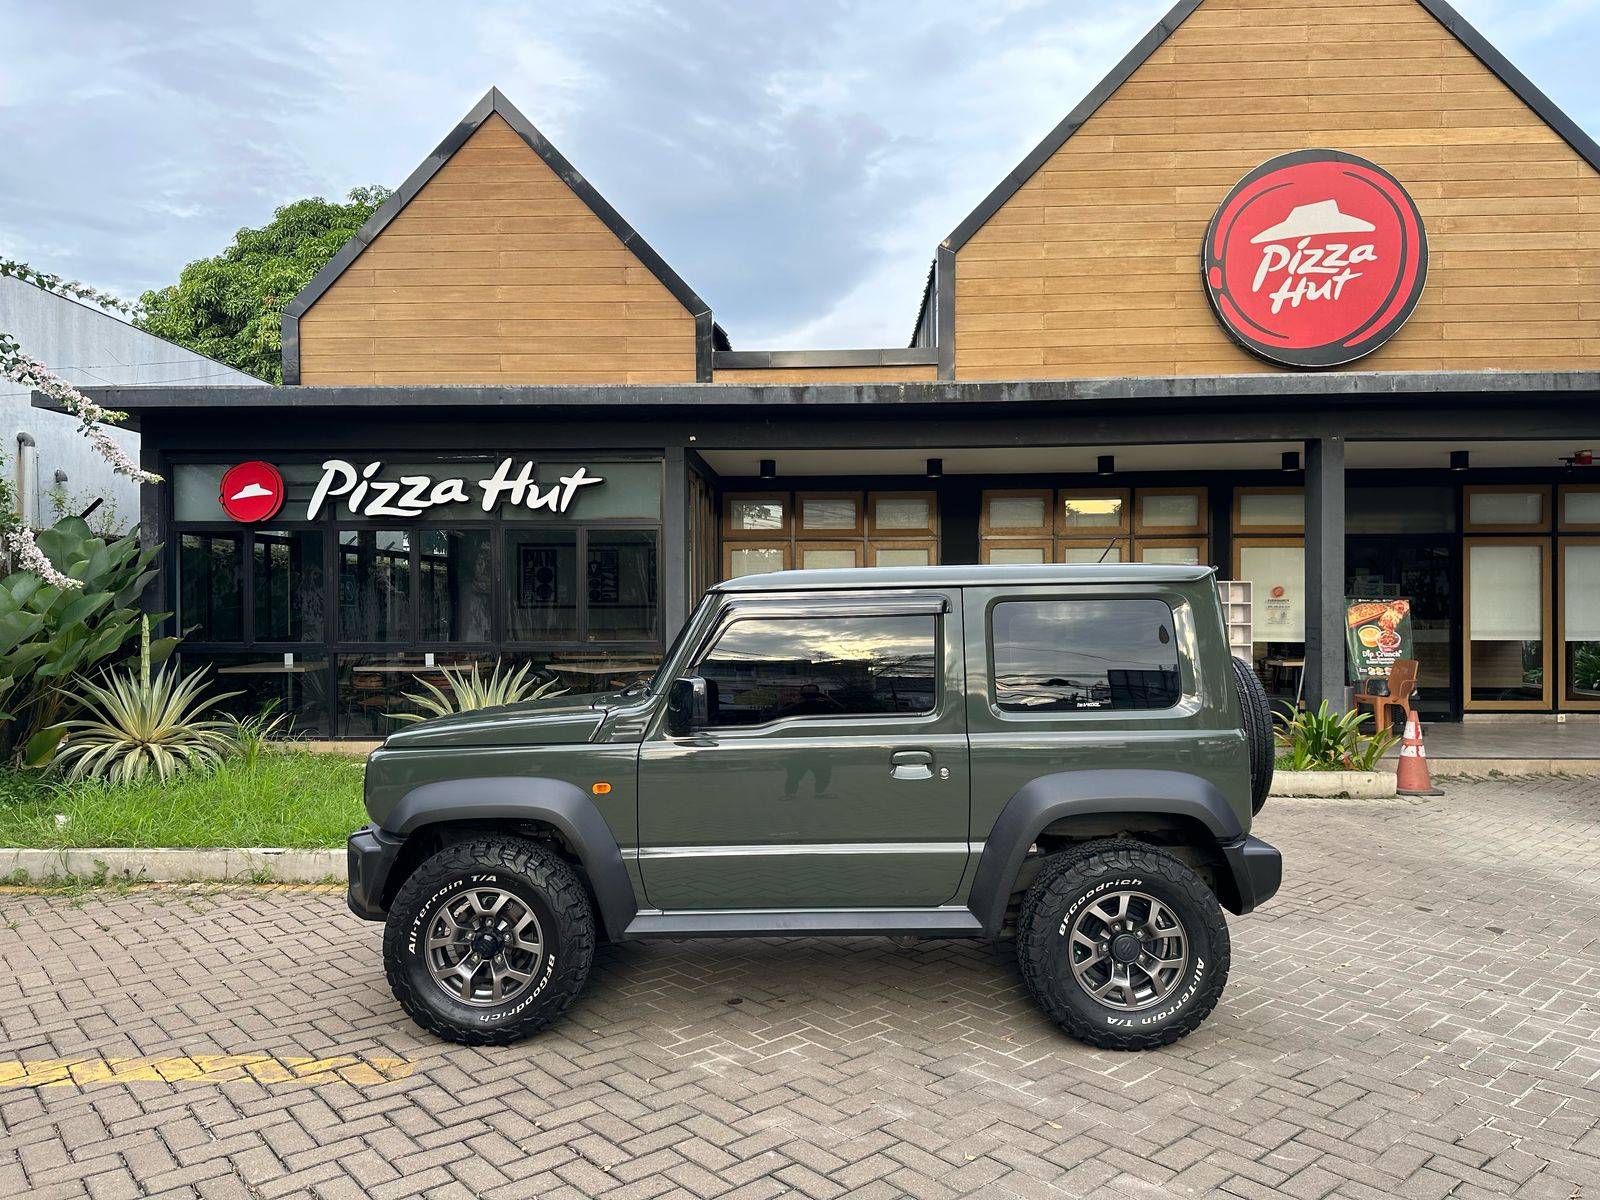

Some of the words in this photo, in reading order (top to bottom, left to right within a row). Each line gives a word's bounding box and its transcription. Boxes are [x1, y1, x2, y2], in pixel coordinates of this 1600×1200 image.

[1252, 236, 1378, 293] Pizza
[1269, 267, 1363, 315] Hut
[306, 459, 469, 521] Pizza
[478, 457, 603, 513] Hut
[1362, 649, 1375, 660] Dip
[408, 879, 464, 955] All-Terrain
[1059, 878, 1143, 936] BFGoodrich
[479, 953, 556, 1023] BFGoodrich
[1142, 957, 1205, 1025] All-Terrain
[1107, 1016, 1134, 1027] T/A
